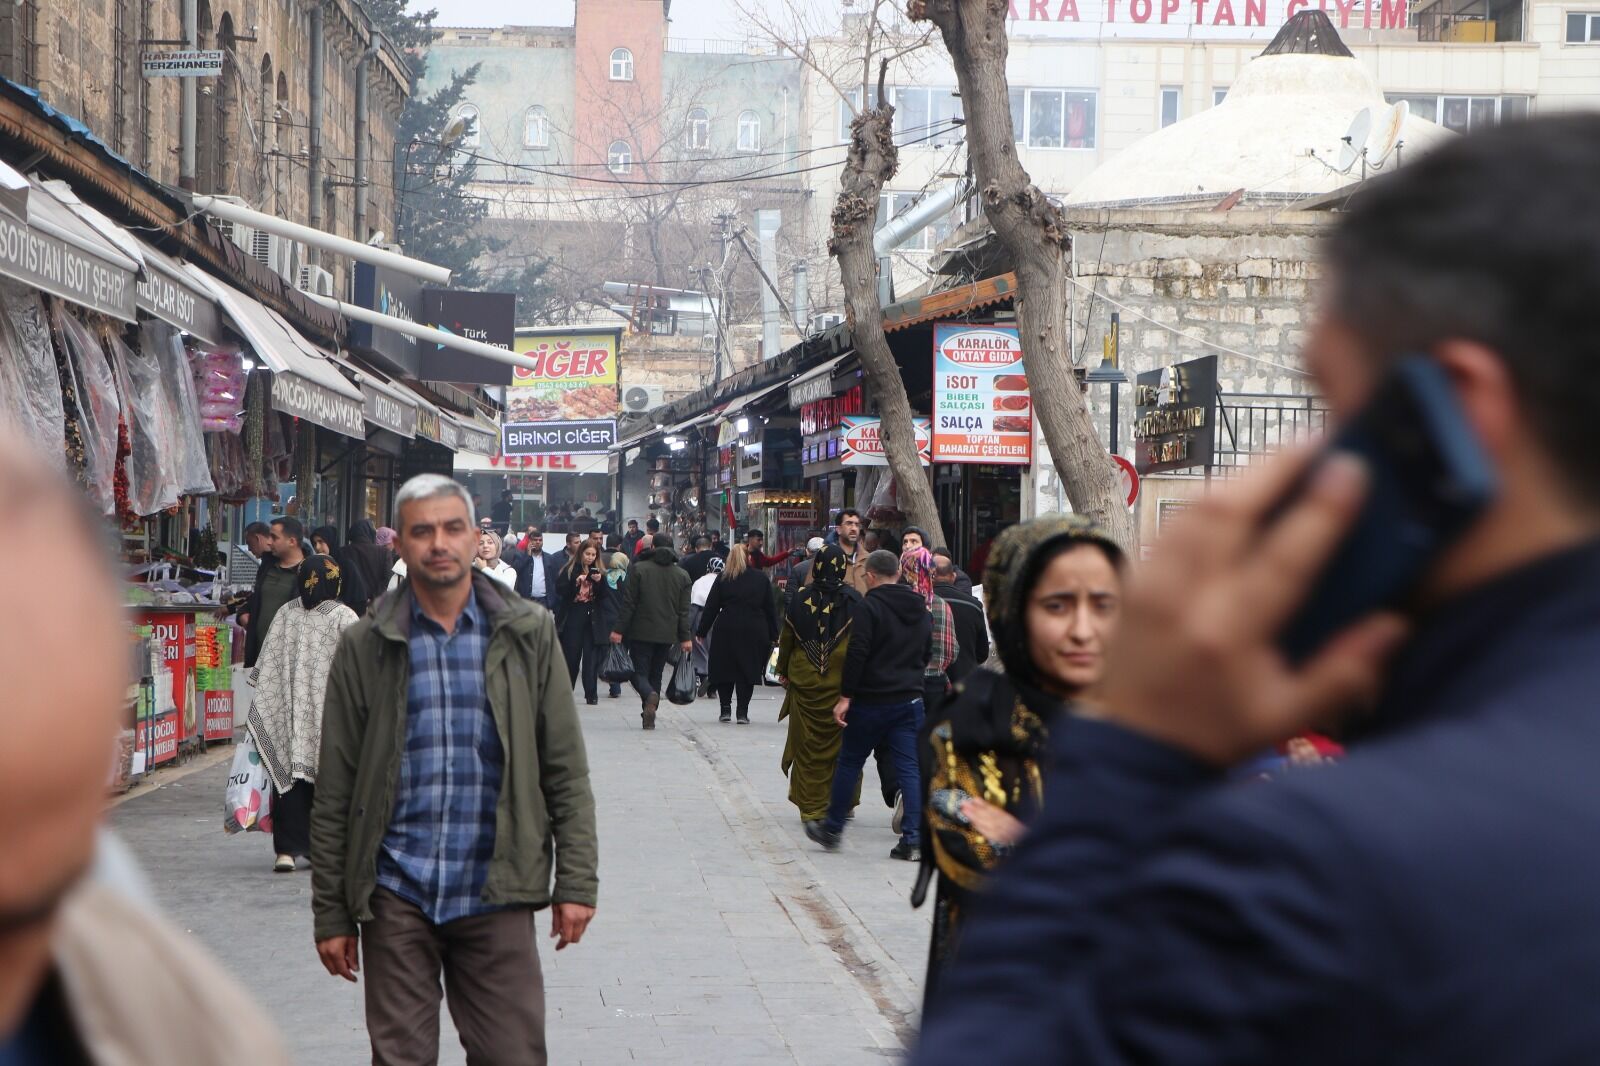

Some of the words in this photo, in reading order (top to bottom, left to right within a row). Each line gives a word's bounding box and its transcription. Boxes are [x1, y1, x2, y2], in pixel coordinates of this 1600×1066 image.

[1104, 0, 1266, 26] TOPTAN
[63, 243, 91, 293] İSOT
[92, 264, 125, 310] ŞEHRİ
[176, 283, 195, 326] İSOT
[463, 328, 487, 339] Türk
[957, 336, 1010, 350] KARALÖK
[515, 341, 609, 378] CİĞER
[952, 351, 986, 362] OKTAY
[989, 351, 1015, 362] GIDA
[939, 401, 985, 411] SALÇASI
[940, 415, 983, 432] SALÇA
[508, 430, 561, 447] BİRİNCİ
[564, 428, 611, 444] CİĞER
[966, 434, 1000, 445] TOPTAN
[939, 444, 980, 454] BAHARAT
[982, 443, 1026, 457] ÇEŞİTLERİ
